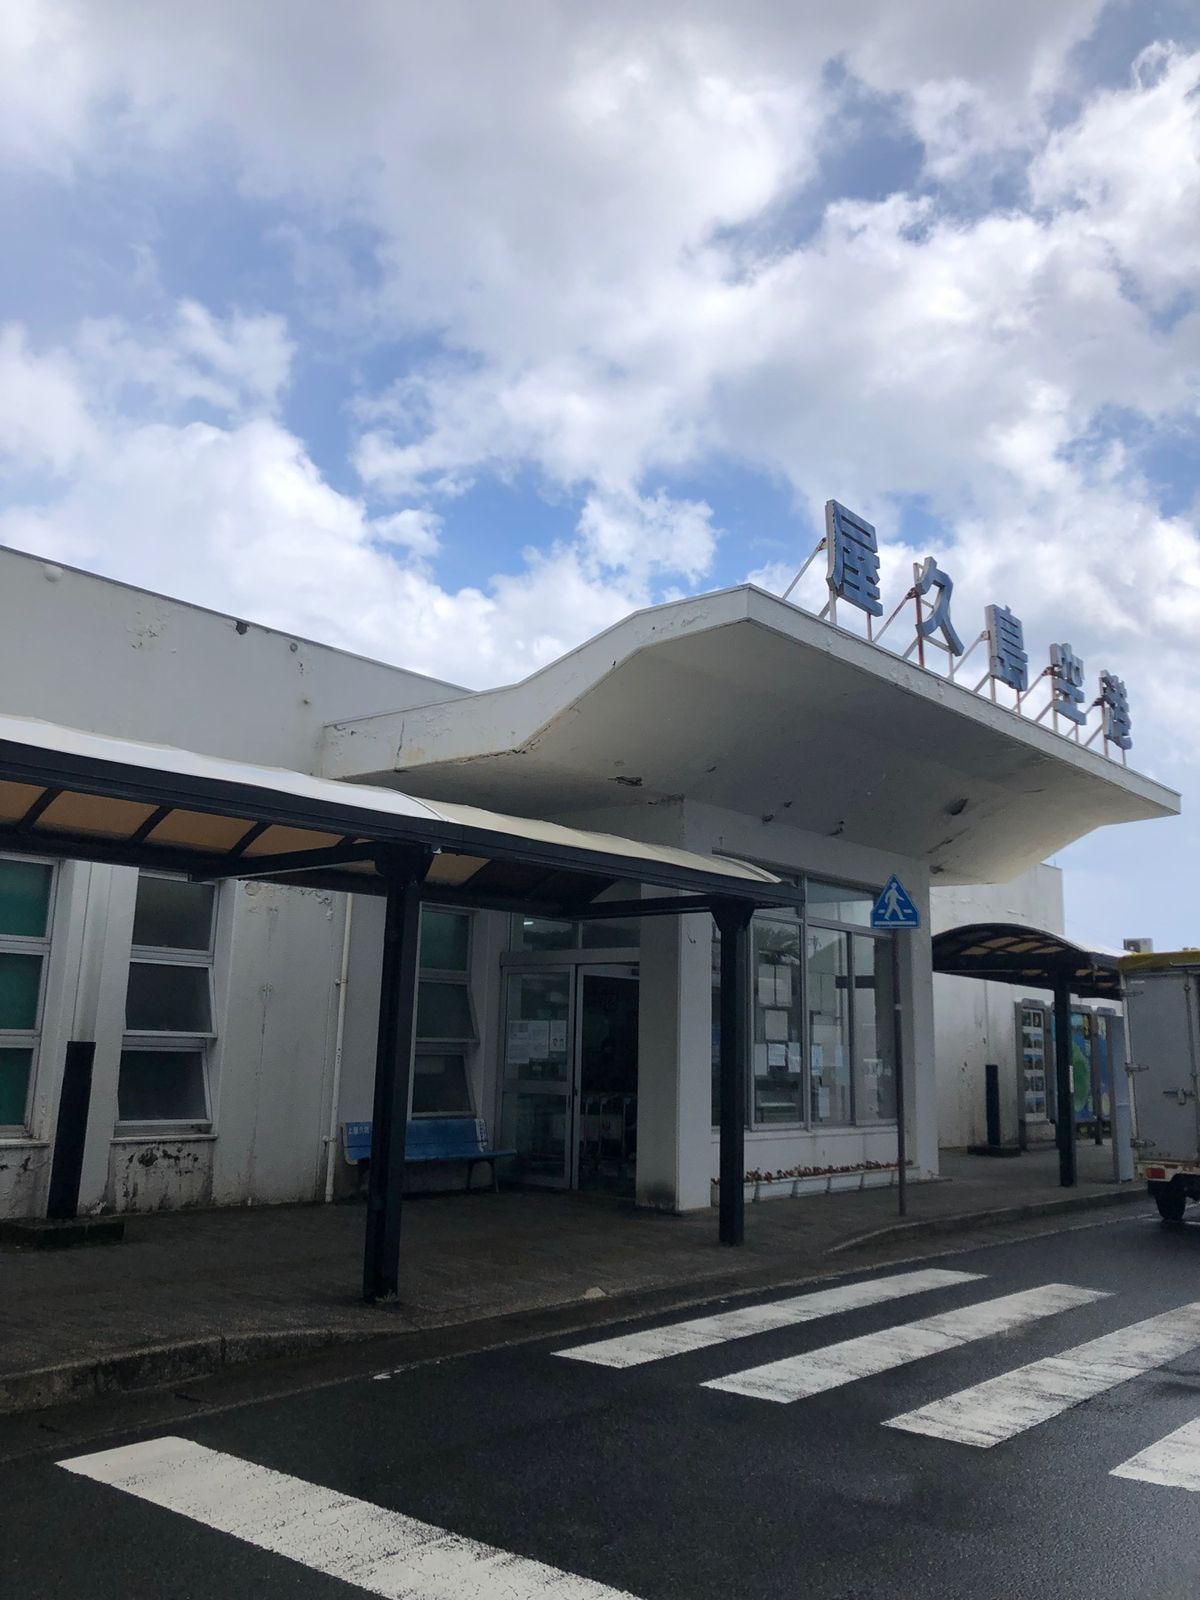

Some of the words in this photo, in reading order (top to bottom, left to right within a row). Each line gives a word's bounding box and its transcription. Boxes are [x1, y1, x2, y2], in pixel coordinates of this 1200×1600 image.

[825, 499, 1132, 750] 屋久島空港
